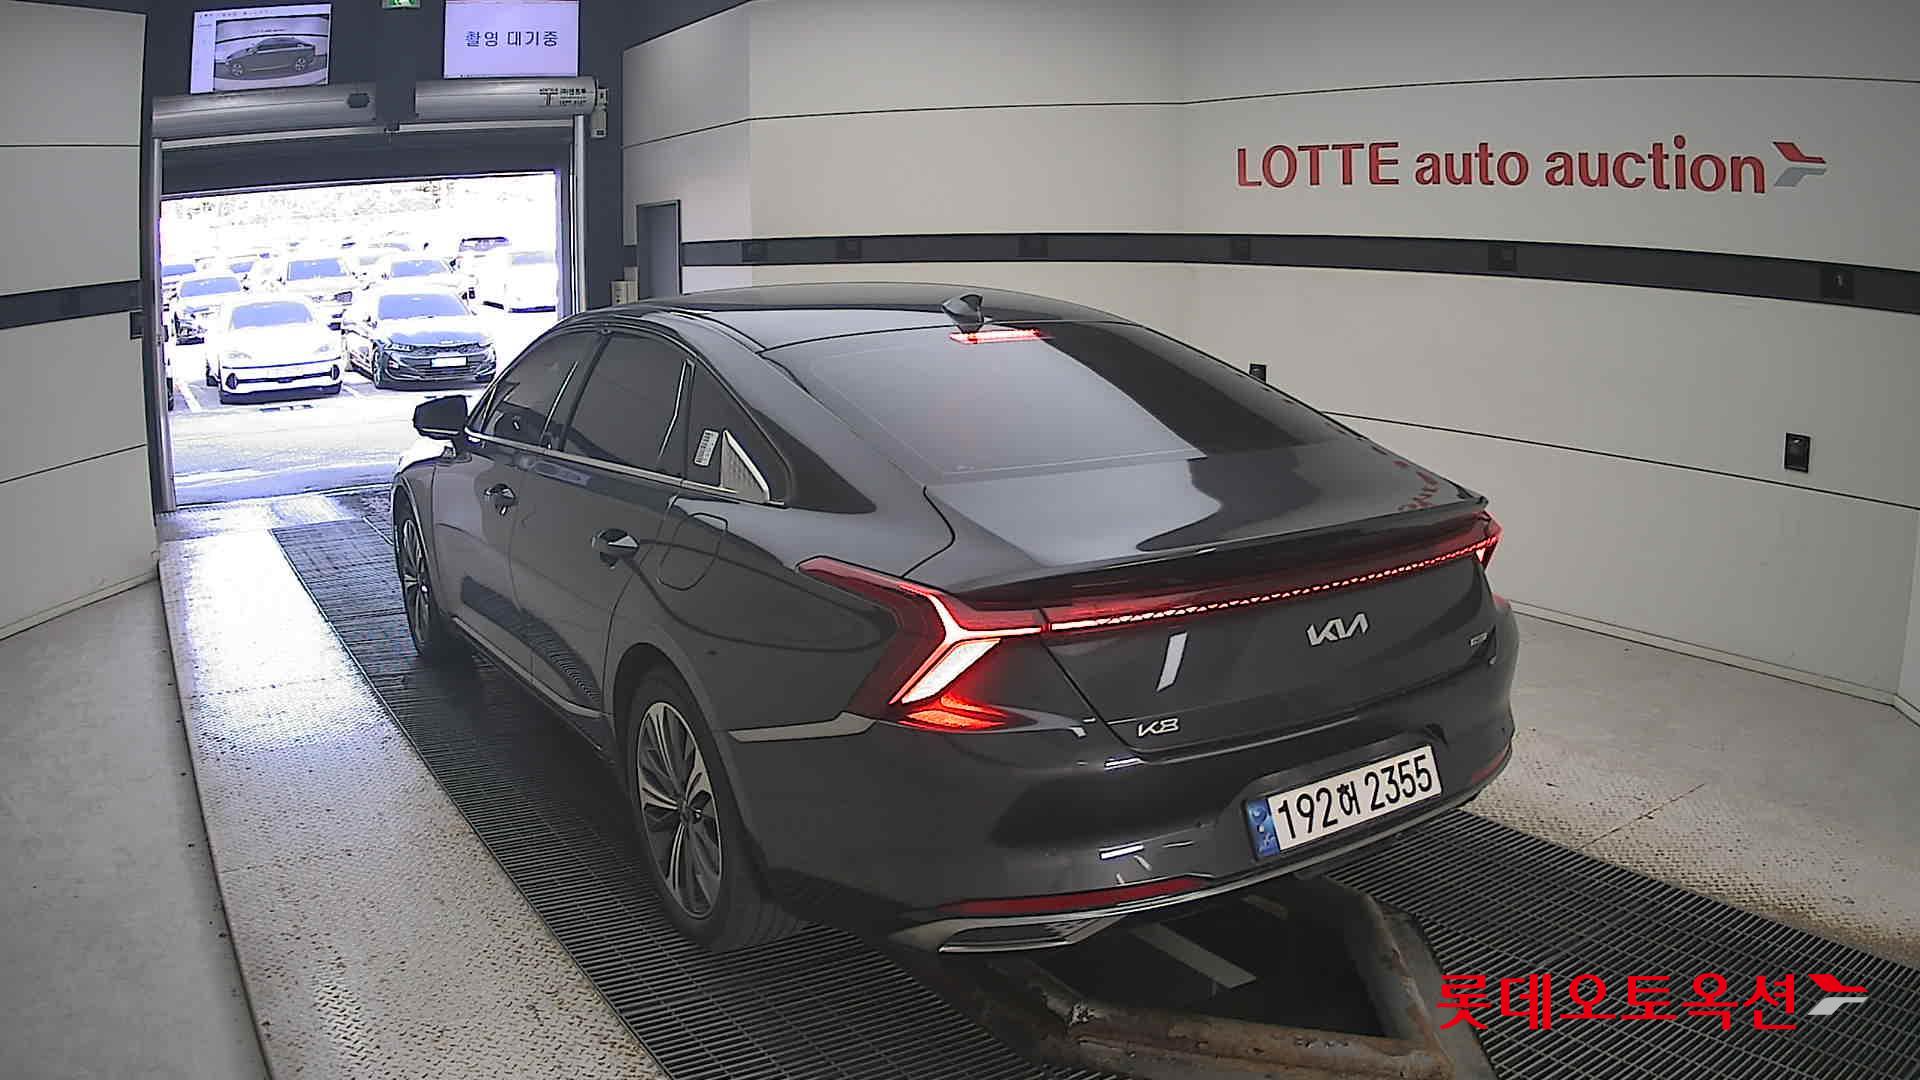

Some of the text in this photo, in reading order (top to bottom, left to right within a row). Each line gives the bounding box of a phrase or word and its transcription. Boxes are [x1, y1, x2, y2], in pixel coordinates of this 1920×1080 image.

[464, 31, 558, 47] 촬영 대기중
[1237, 135, 1766, 194] LOTTE auto auction
[1307, 613, 1369, 646] KIA
[1138, 718, 1179, 737] K8
[1278, 754, 1433, 840] 192허 2355
